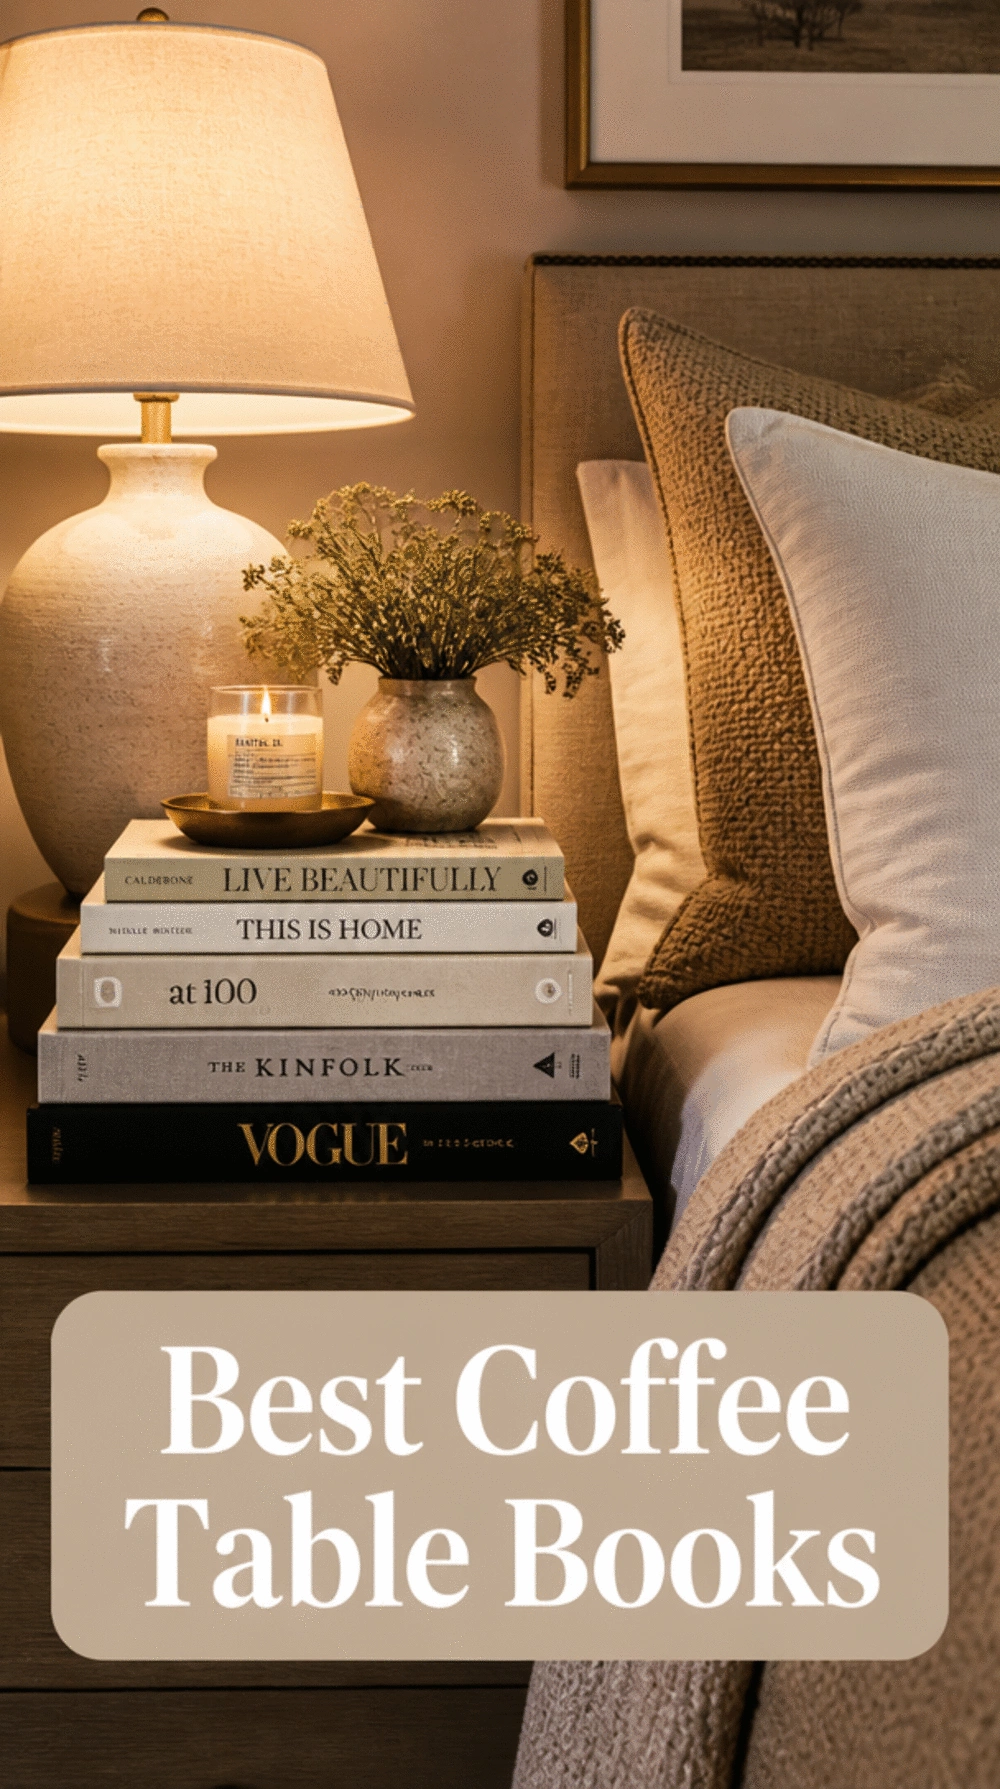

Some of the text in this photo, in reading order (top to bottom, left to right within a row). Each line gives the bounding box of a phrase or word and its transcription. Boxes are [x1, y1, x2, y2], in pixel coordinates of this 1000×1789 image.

[223, 866, 502, 892] LIVE BEAUTIFULLY
[236, 918, 423, 940] THIS IS HOME
[169, 982, 198, 1005] at
[208, 1061, 246, 1073] THE
[255, 1057, 405, 1078] KINFOLK
[237, 1122, 408, 1166] VOGUE
